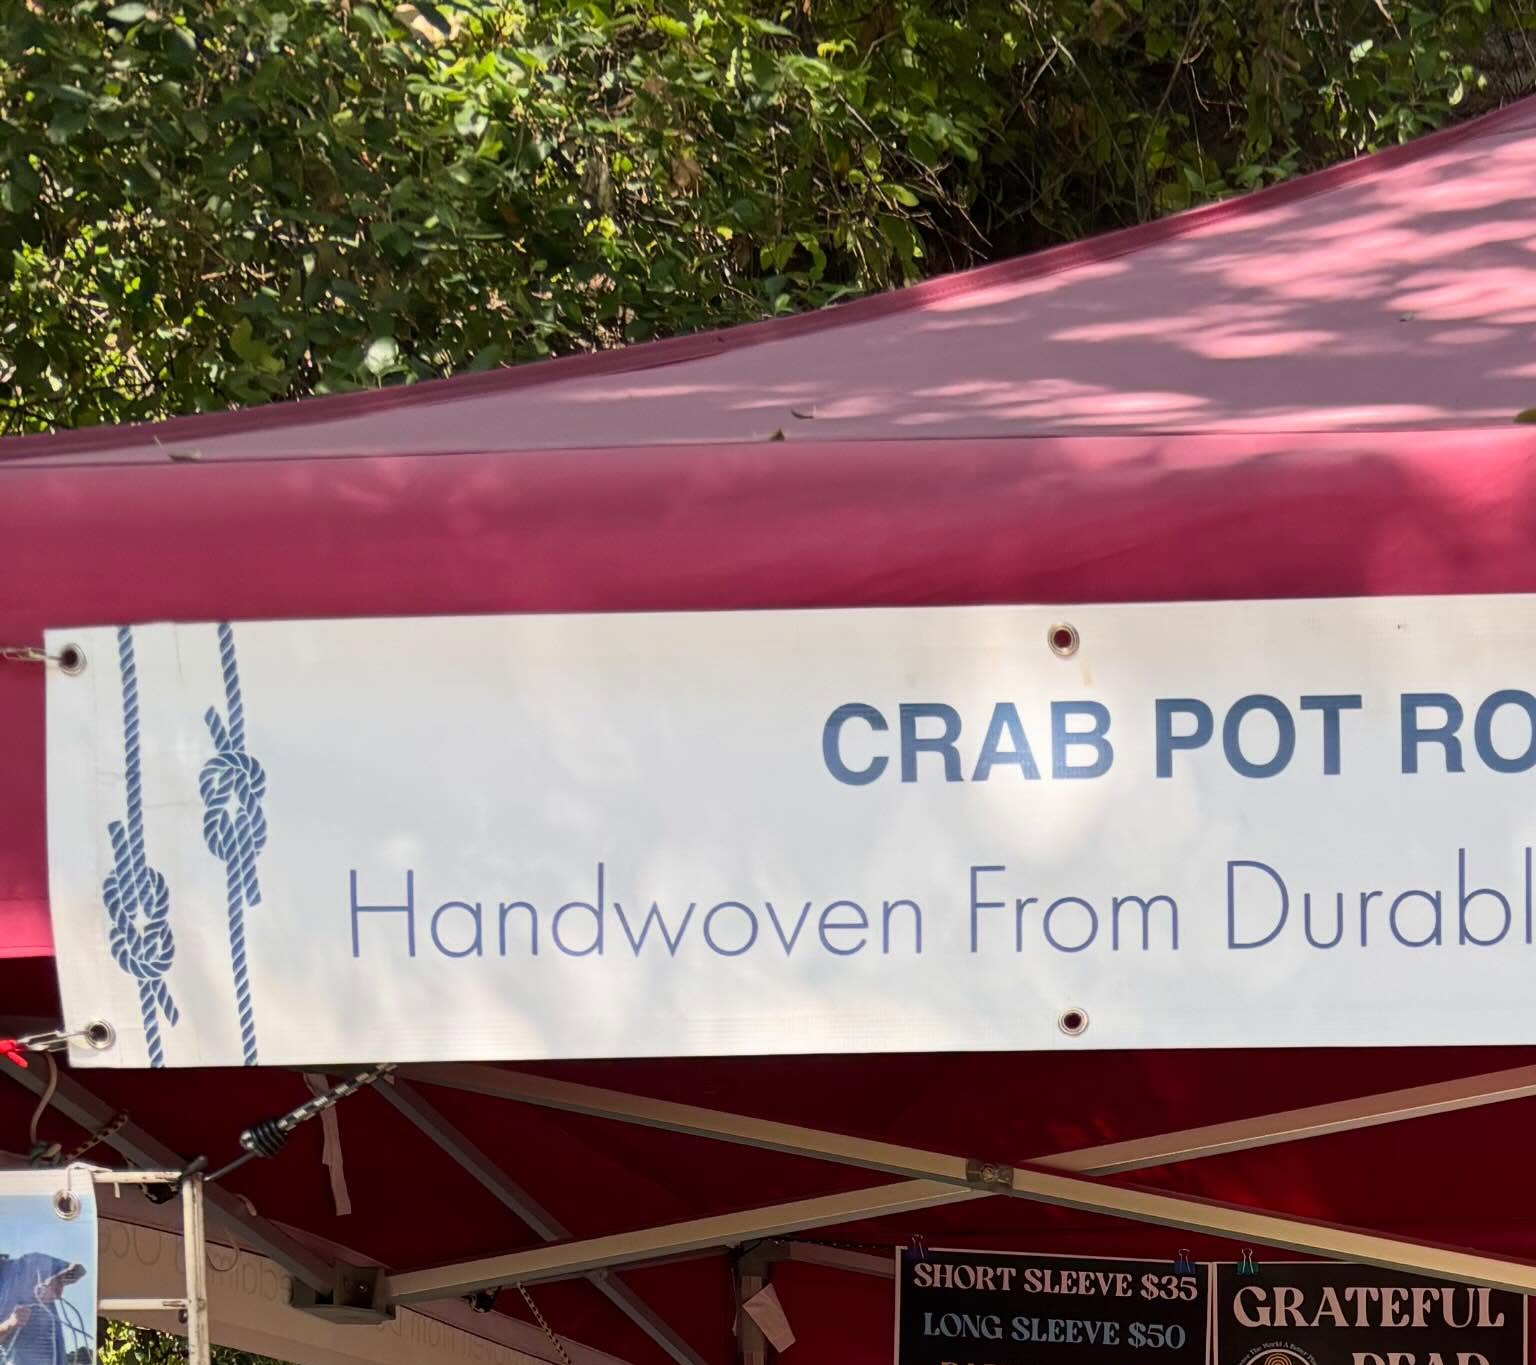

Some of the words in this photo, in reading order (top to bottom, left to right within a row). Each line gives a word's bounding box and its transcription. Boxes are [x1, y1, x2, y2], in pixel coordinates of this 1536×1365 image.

[820, 697, 1114, 785] CRAB
[1154, 693, 1362, 779] POT
[348, 862, 923, 959] Handwoven
[970, 862, 1180, 954] From
[913, 1262, 1016, 1292] SHORT
[1023, 1267, 1133, 1297] SLEEVE
[1140, 1271, 1198, 1301] $35
[1233, 1286, 1505, 1328] GRATEFUL
[923, 1312, 1004, 1340] LONG
[1012, 1316, 1120, 1345] SLEEVE
[1128, 1320, 1186, 1349] $50
